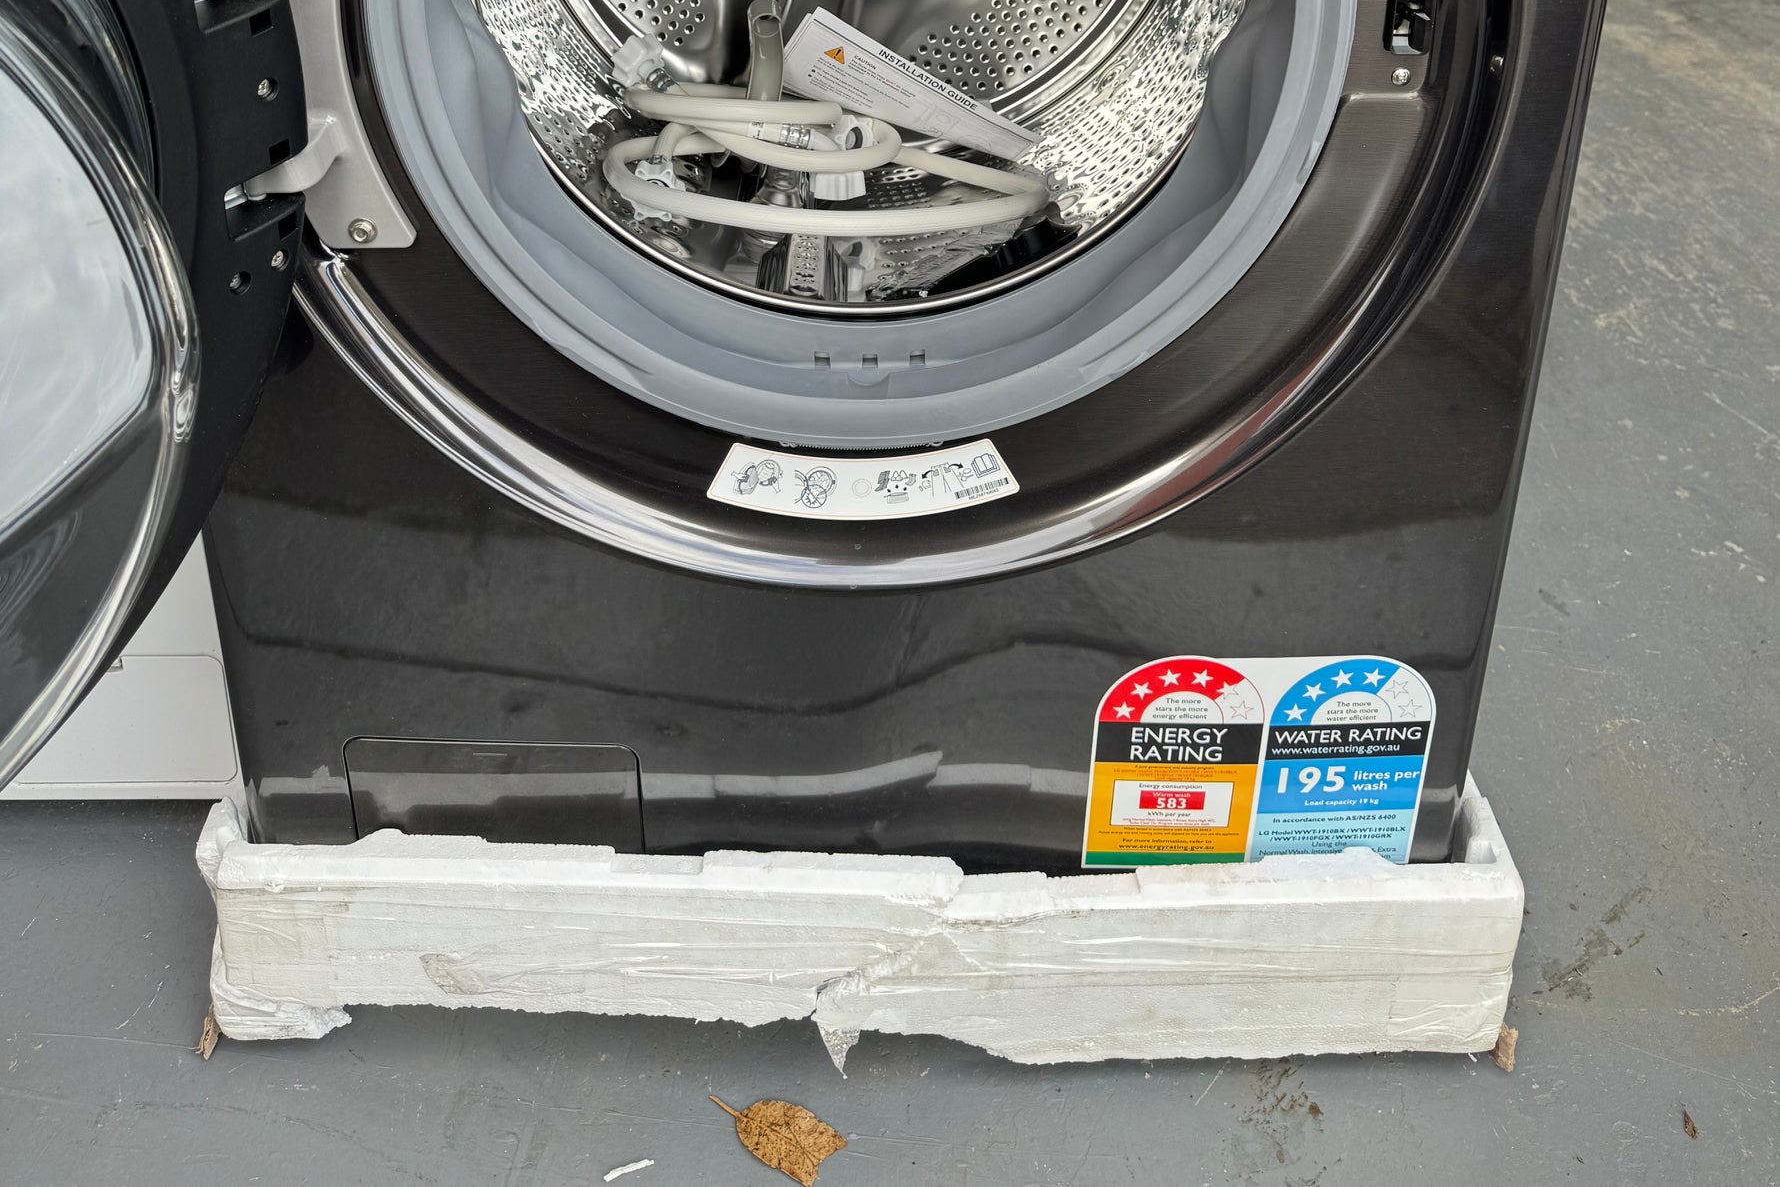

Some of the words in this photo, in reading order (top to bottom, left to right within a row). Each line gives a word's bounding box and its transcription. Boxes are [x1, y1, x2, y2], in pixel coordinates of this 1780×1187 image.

[879, 49, 946, 92] INSTALLATION
[947, 90, 978, 110] GUIDE
[1131, 727, 1228, 745] ENERGY
[1275, 730, 1342, 744] WATER
[1348, 727, 1422, 742] RATING
[1130, 745, 1223, 762] RATING
[1272, 744, 1400, 755] www.waterrating.gov.au
[1277, 766, 1347, 794] 195
[1353, 770, 1390, 781] litres
[1394, 770, 1421, 782] per
[1352, 781, 1387, 791] wash
[1156, 797, 1187, 809] 583
[1325, 798, 1357, 806] capacity
[1369, 797, 1379, 805] kg
